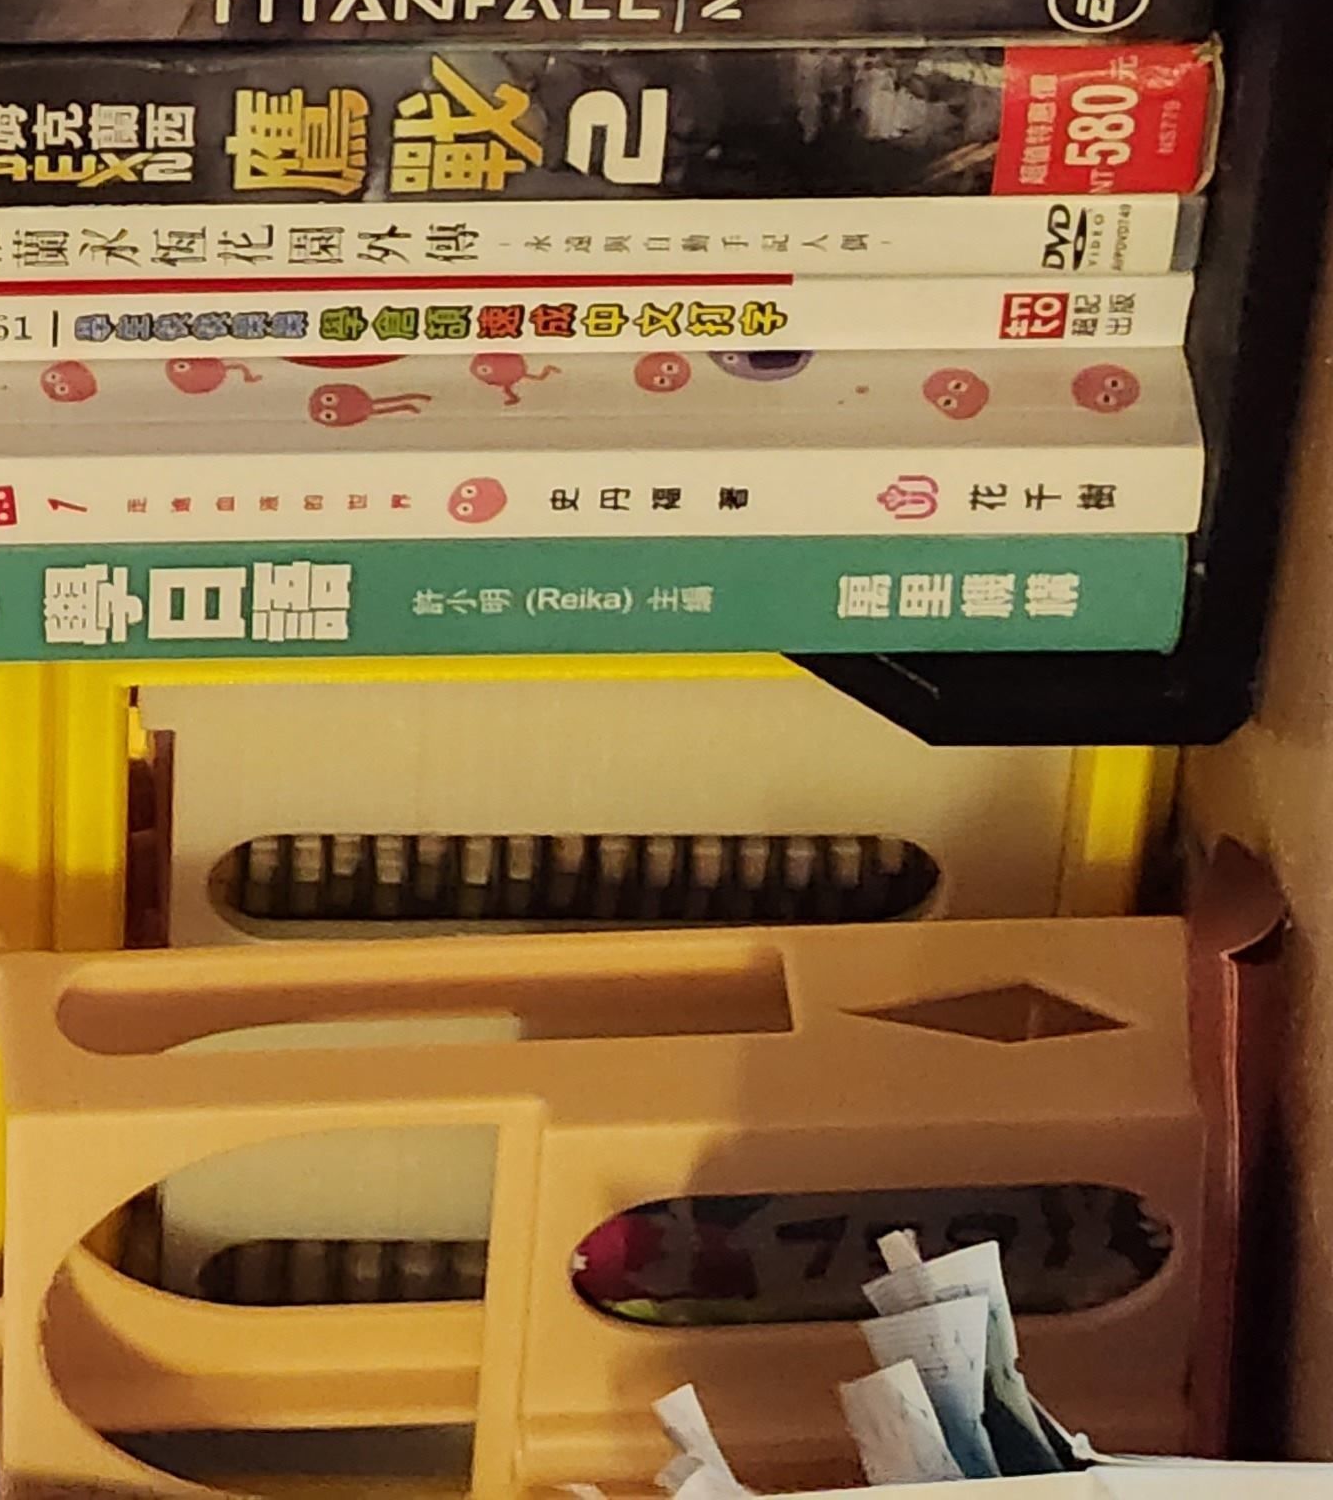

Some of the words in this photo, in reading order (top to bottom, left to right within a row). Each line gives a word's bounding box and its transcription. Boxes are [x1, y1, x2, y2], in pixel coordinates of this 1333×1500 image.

[1041, 203, 1072, 271] DVD
[1087, 213, 1105, 268] VIDEO
[550, 486, 681, 513] 史丹福
[718, 487, 748, 512] 著
[969, 482, 1117, 512] 花千樹
[42, 560, 352, 645] 學日語
[412, 587, 513, 616] 許小明
[524, 585, 633, 616] (Reika)
[646, 584, 715, 614] 主編
[836, 572, 1081, 619] 萬里機構
